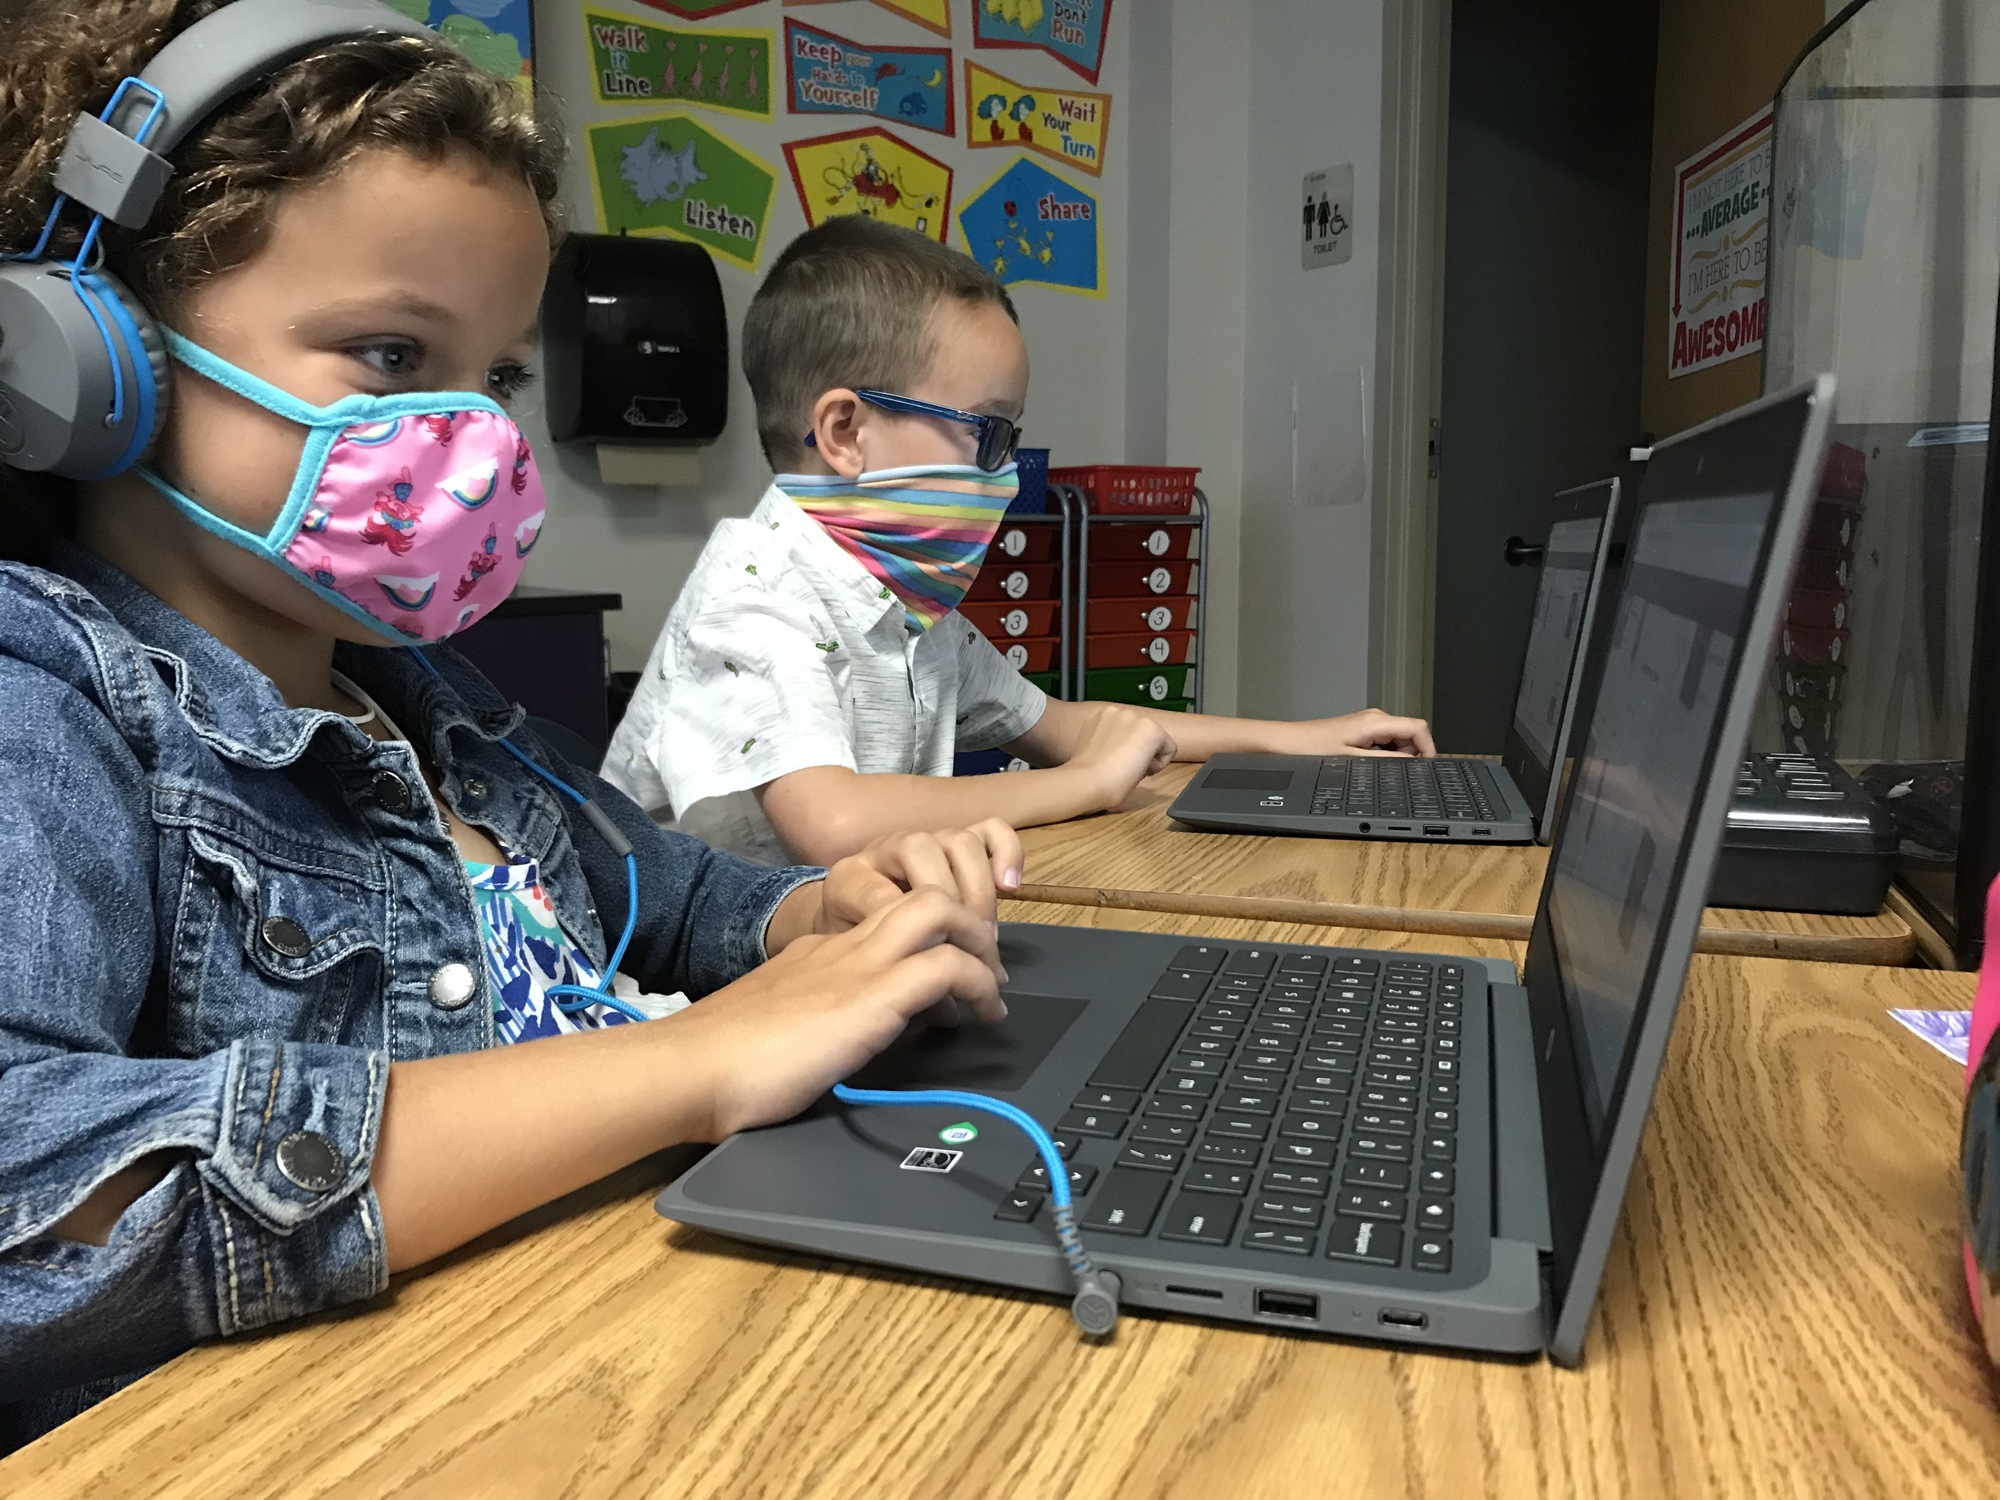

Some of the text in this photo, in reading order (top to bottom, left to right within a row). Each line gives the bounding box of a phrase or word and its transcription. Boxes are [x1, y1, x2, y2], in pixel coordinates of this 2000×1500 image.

[594, 25, 648, 52] Walk
[1053, 18, 1085, 47] Run
[796, 36, 842, 68] Keep
[603, 70, 651, 95] Line
[798, 80, 878, 110] Yourself
[1058, 97, 1096, 123] Wait
[1042, 112, 1072, 131] Your
[1060, 134, 1096, 160] Turn
[1724, 163, 1745, 193] HERE
[1749, 154, 1762, 178] TO
[1038, 192, 1091, 220] Share
[684, 200, 755, 239] Listen
[1312, 241, 1337, 254] TOILET
[1687, 268, 1702, 296] I'M
[1706, 255, 1730, 289] HERE
[1735, 247, 1750, 274] TO
[1012, 576, 1024, 593] 2
[1156, 572, 1166, 588] 2
[1010, 614, 1022, 631] 3
[1154, 611, 1165, 627] 3
[1012, 649, 1022, 665] 4
[1155, 642, 1164, 656] 4
[1153, 679, 1164, 695] 5
[1259, 1038, 1279, 1046] g
[1189, 1060, 1205, 1068] n
[1256, 1056, 1277, 1064] h
[1178, 1078, 1195, 1089] m
[1243, 1075, 1268, 1083] j
[1239, 1097, 1261, 1105] k
[1289, 1145, 1313, 1156] p
